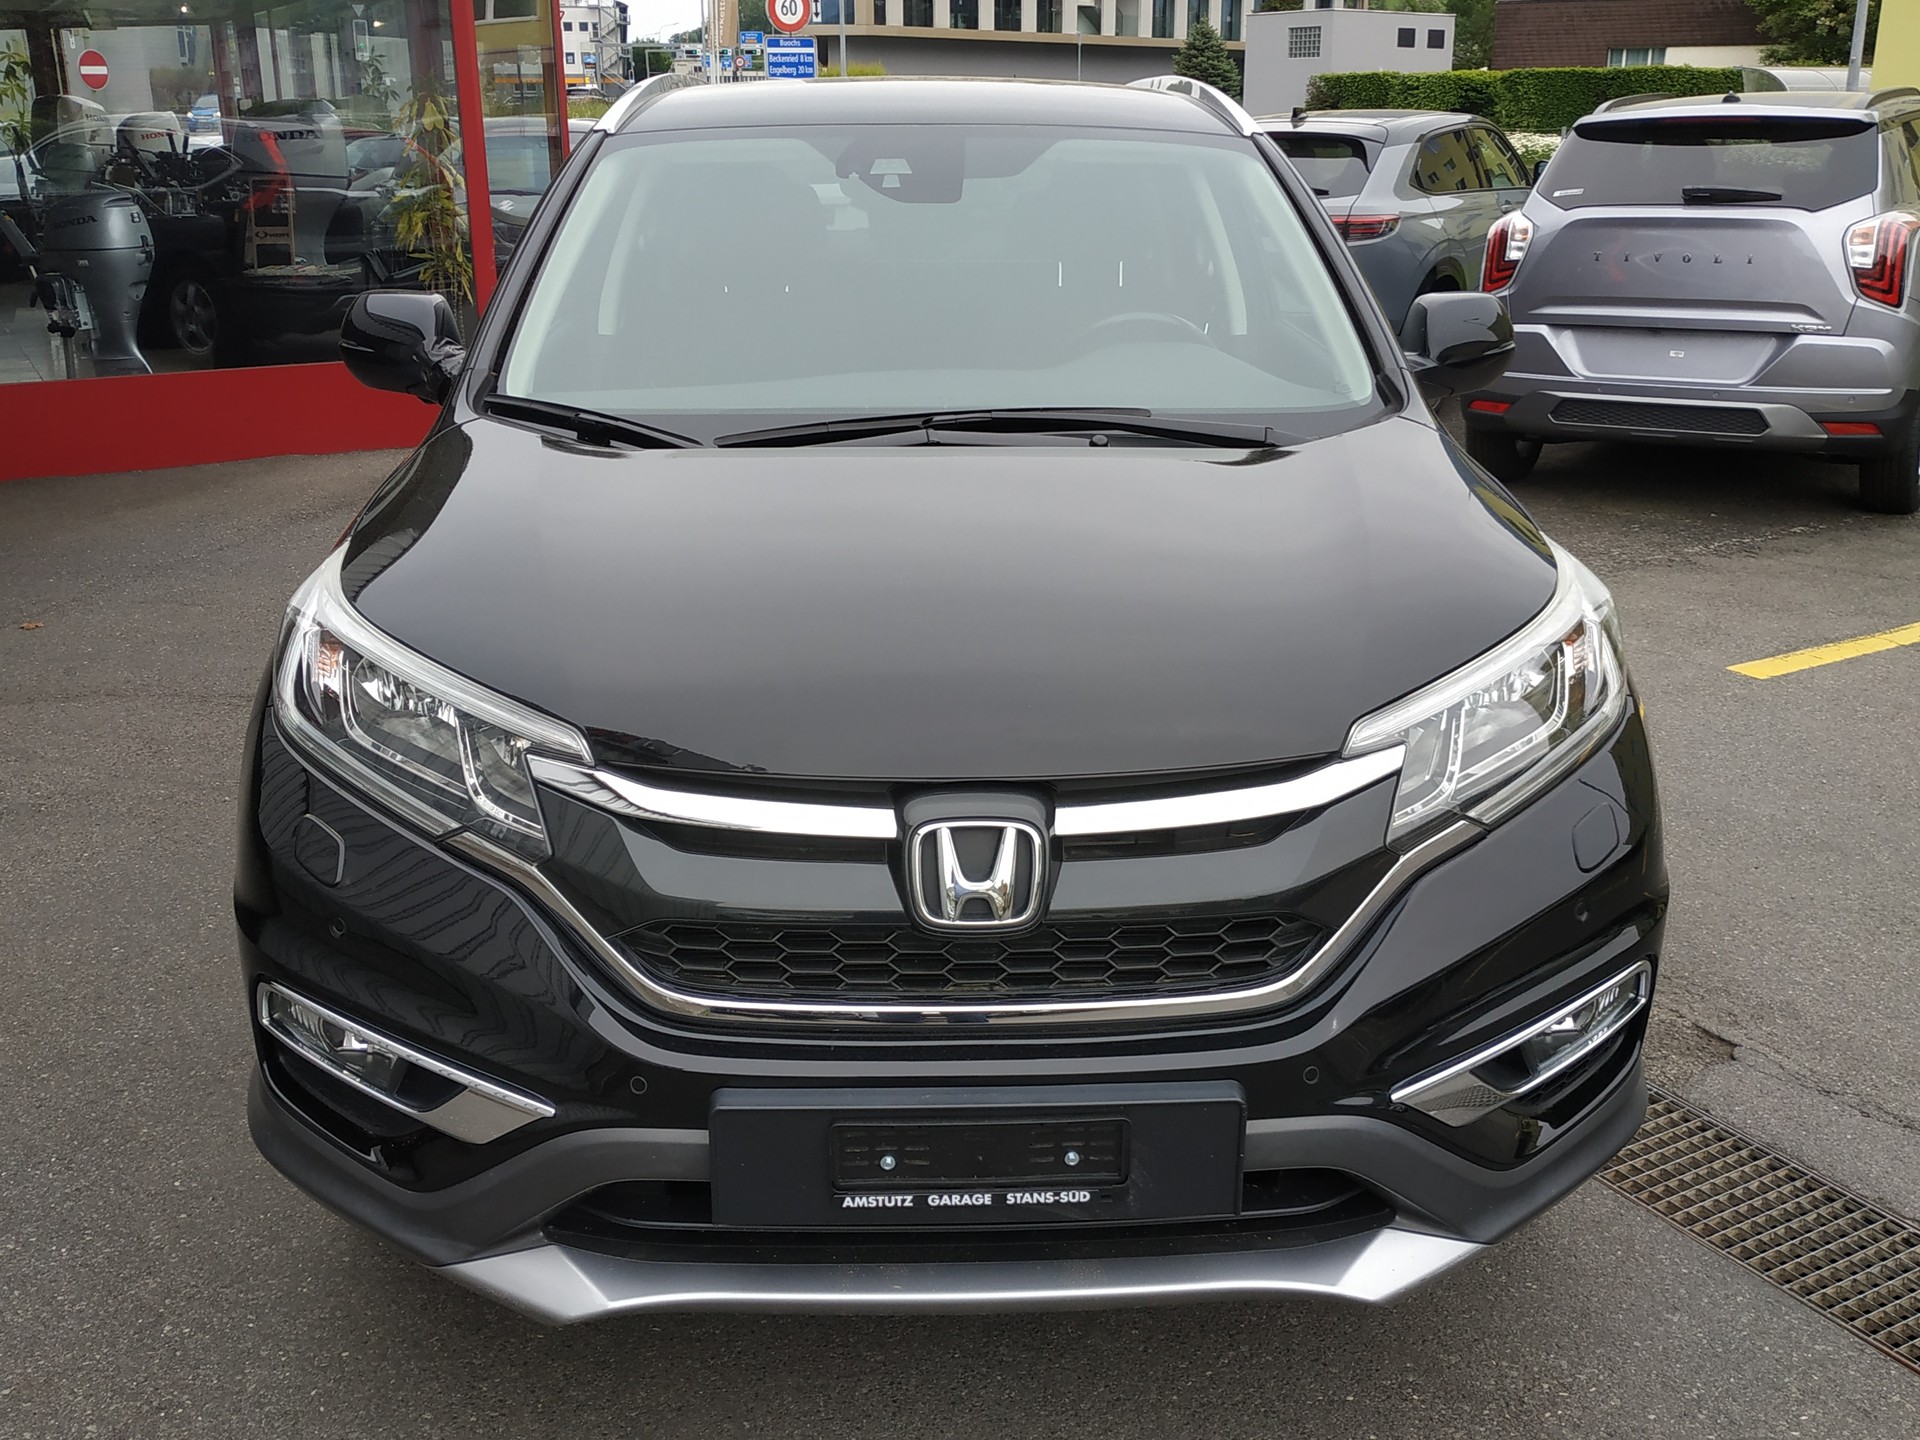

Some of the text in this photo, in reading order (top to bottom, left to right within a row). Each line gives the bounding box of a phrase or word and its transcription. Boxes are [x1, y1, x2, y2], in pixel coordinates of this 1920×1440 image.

[781, 0, 797, 16] 60
[769, 54, 813, 63] Beckenried 8 km
[769, 65, 814, 76] Engelberg 20 km
[1593, 251, 1754, 265] TIVOLI
[842, 1190, 1091, 1208] AMSTUTZ GARAGE STANS-SÜD
